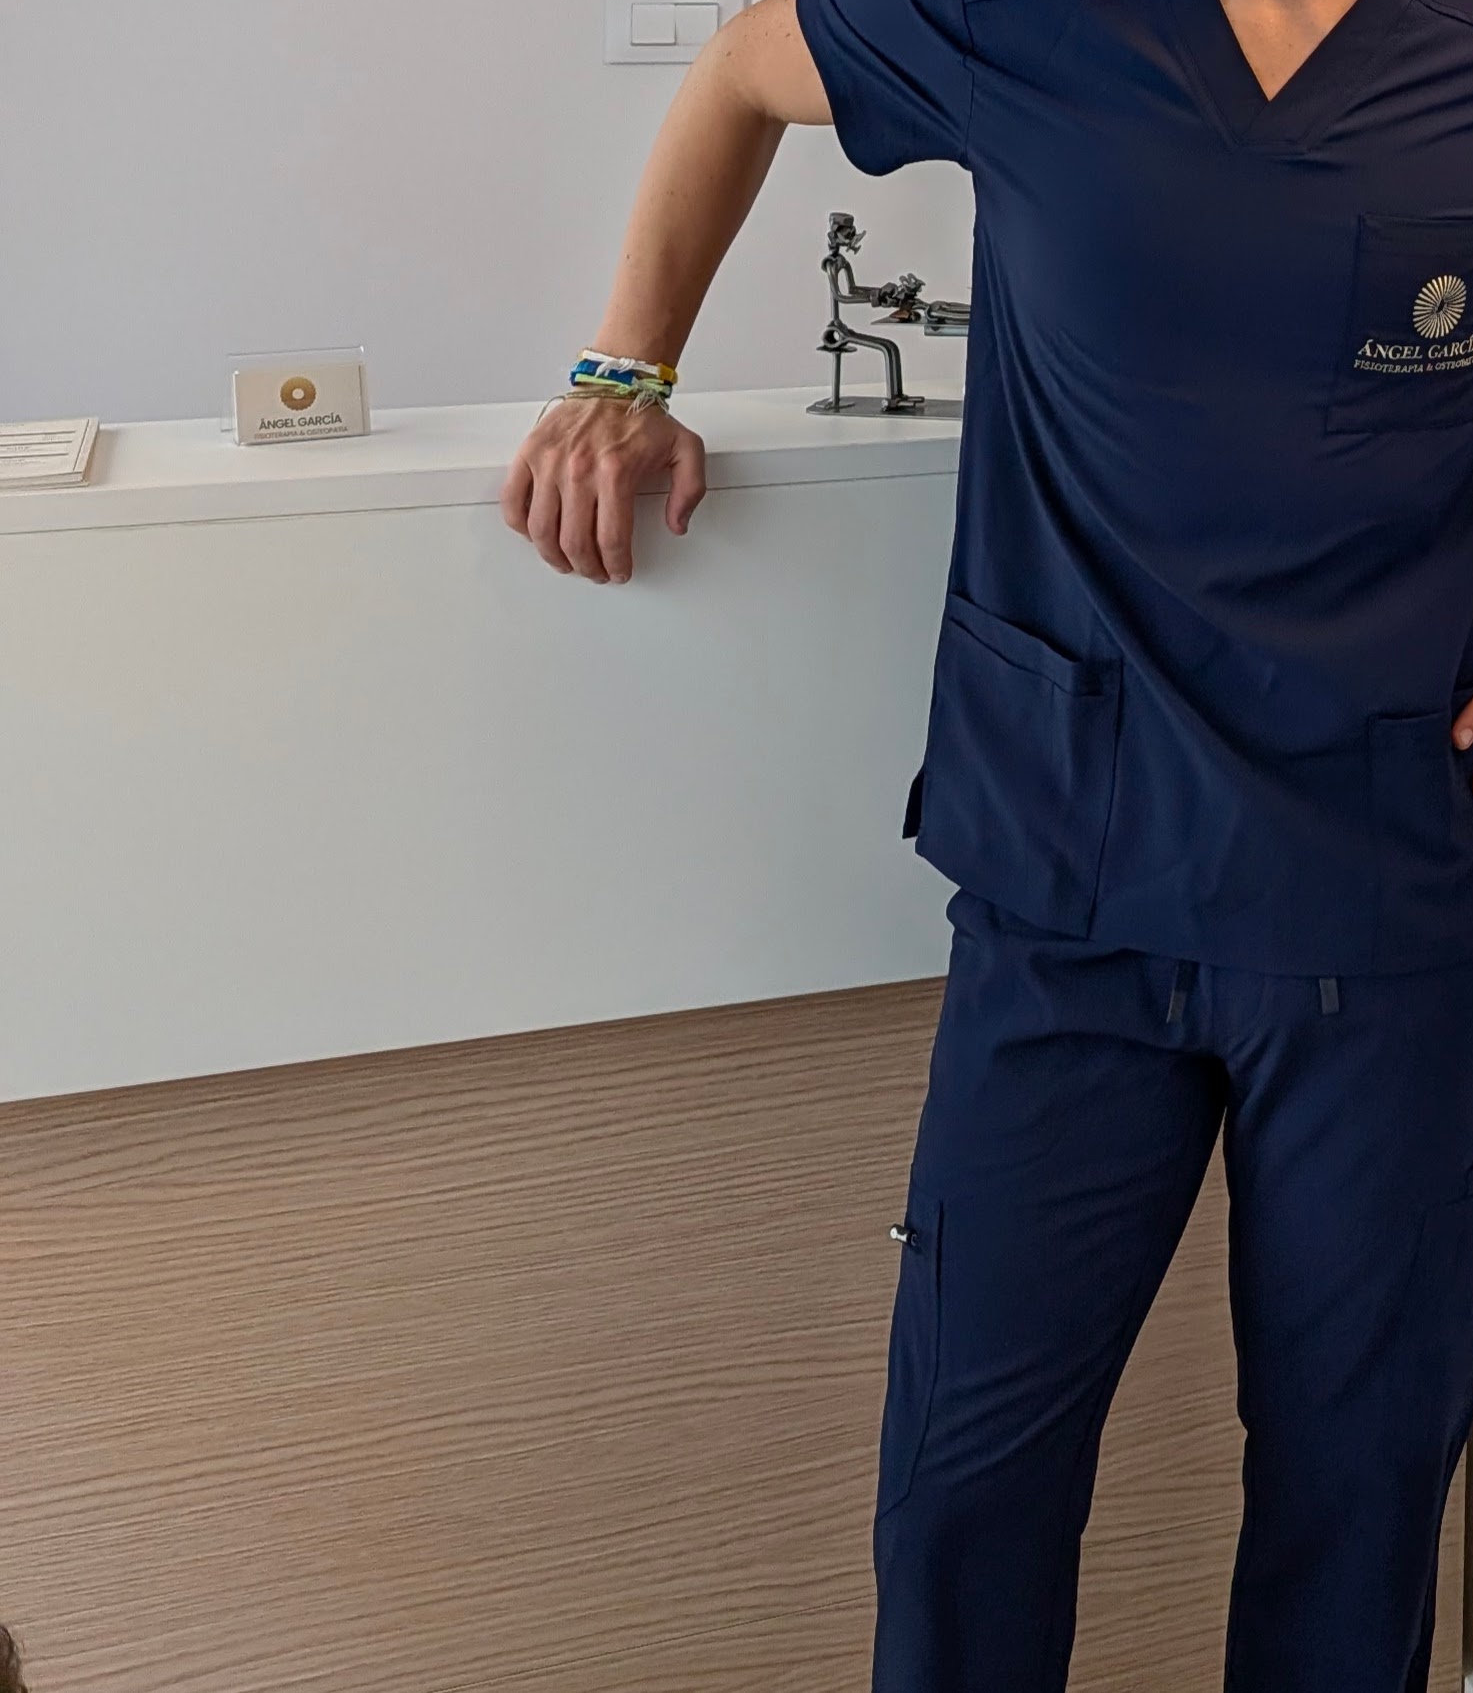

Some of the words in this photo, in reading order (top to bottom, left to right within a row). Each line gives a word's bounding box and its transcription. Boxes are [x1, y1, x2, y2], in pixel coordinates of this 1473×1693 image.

[1357, 338, 1423, 360] ÁNGEL
[1353, 358, 1424, 374] FISIOTERAPIA
[259, 418, 296, 430] ÁNGEL
[297, 412, 342, 427] GARCÍA
